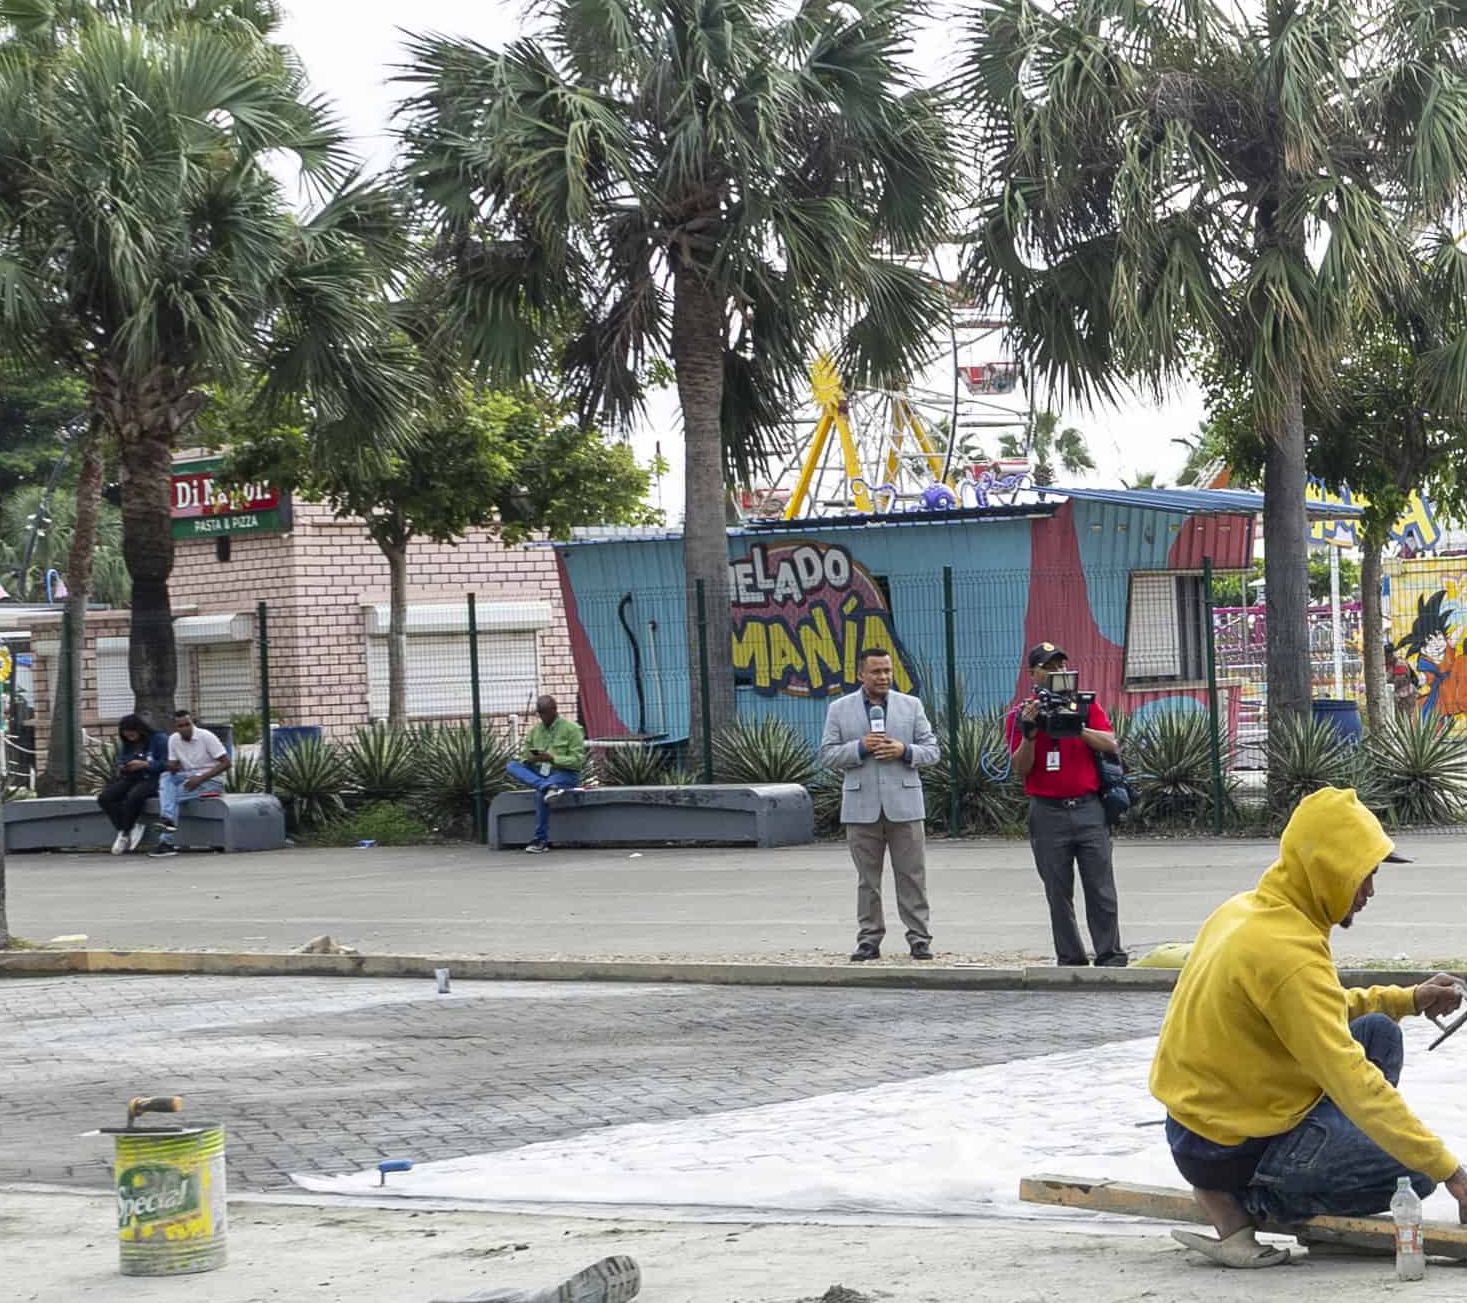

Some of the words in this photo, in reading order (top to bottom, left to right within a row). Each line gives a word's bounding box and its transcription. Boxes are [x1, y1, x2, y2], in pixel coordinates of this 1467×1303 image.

[175, 479, 199, 508] Di
[194, 518, 222, 532] PASTA
[224, 517, 231, 530] &
[232, 514, 259, 529] PIZZA
